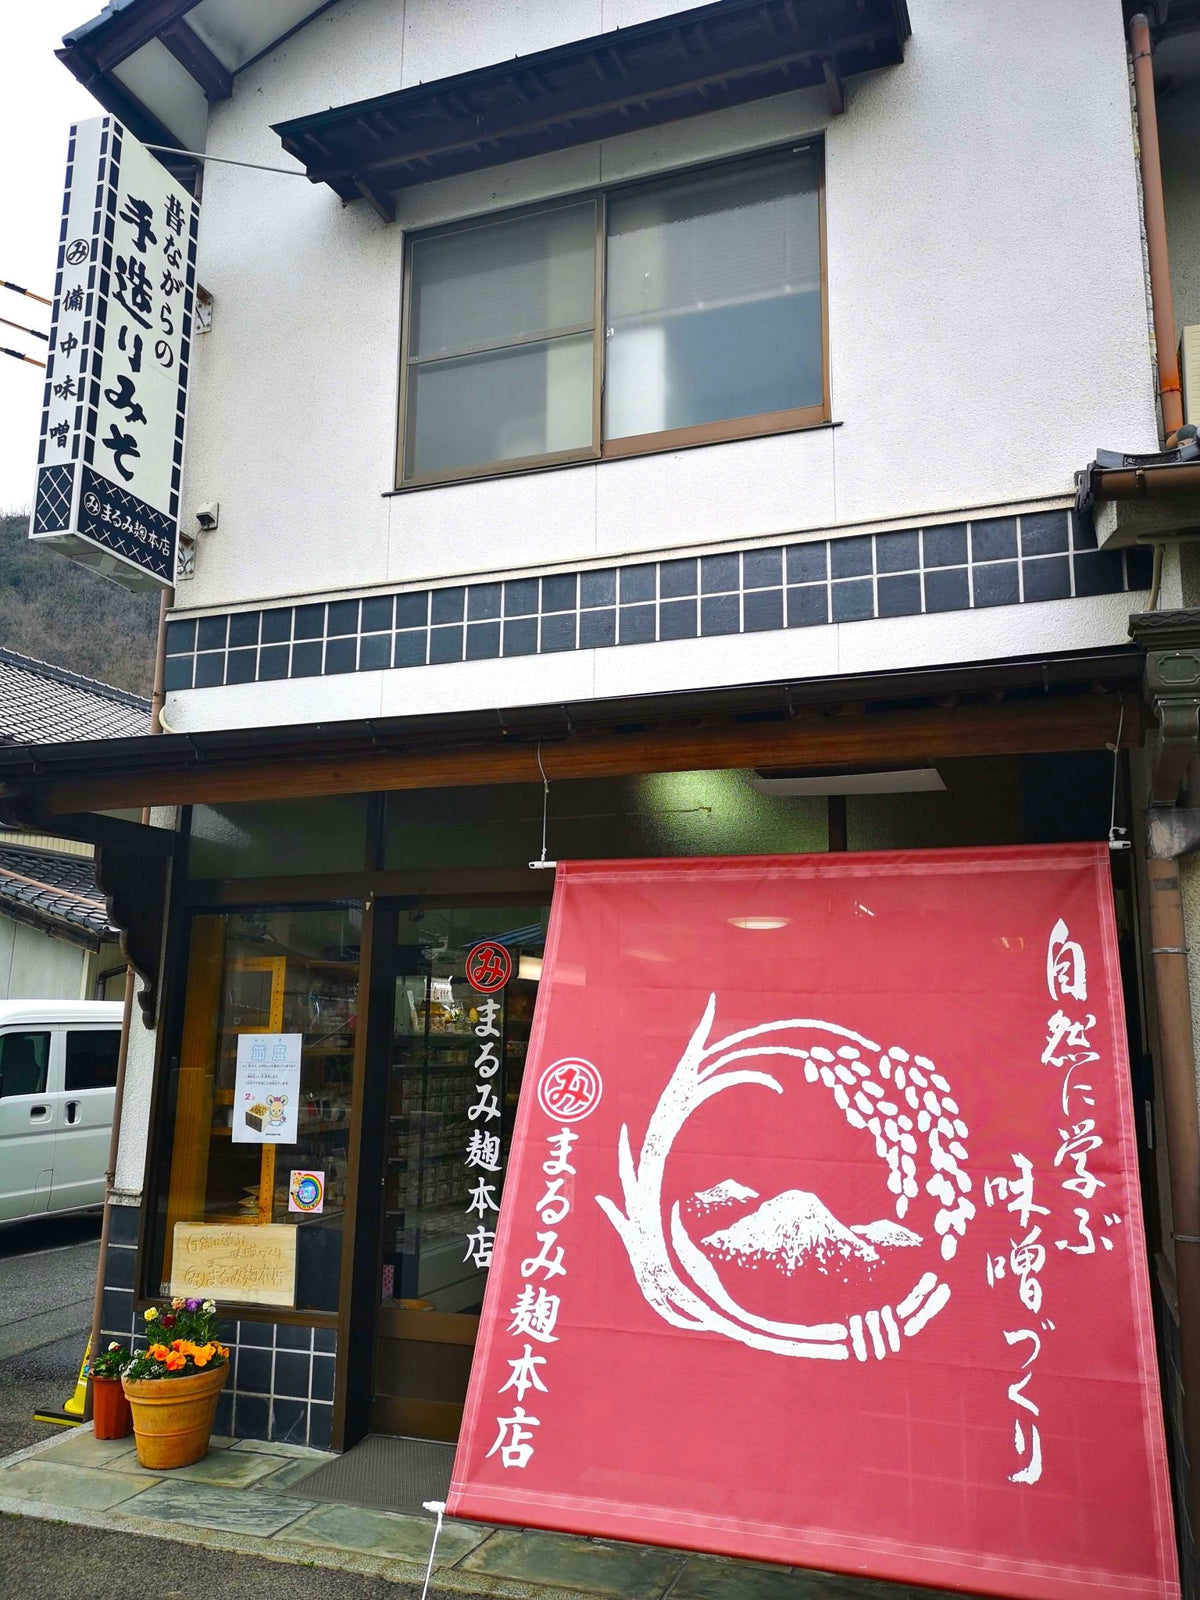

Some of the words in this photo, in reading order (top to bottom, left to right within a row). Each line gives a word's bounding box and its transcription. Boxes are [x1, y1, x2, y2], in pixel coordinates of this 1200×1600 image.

[49, 285, 85, 449] 備中味噌
[103, 193, 157, 482] 手造りみそ
[155, 193, 187, 368] 昔ながらの
[101, 503, 171, 557] まるみ麹本店
[463, 998, 502, 1270] まるみ麹本店
[1040, 917, 1120, 1256] 自然に学ぶ
[485, 1126, 580, 1469] まるみ麹本店
[984, 1152, 1055, 1486] 味噌づくり
